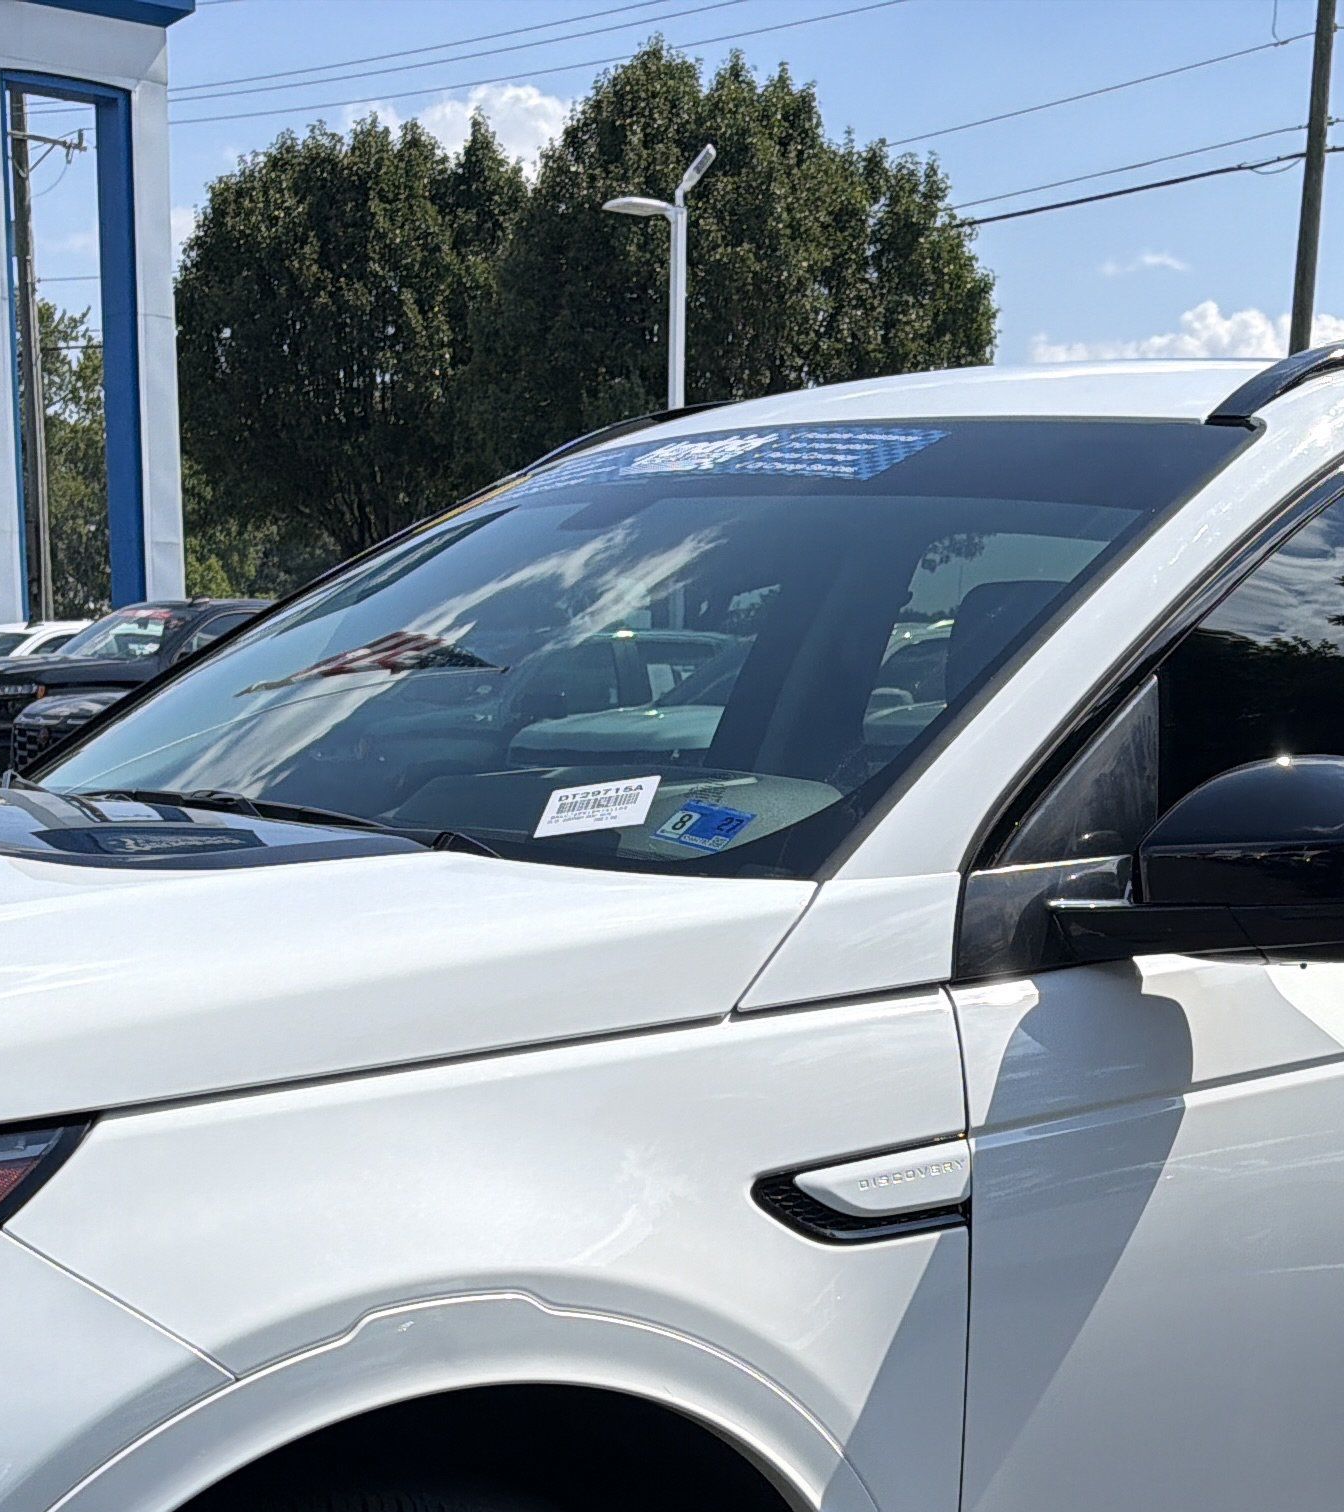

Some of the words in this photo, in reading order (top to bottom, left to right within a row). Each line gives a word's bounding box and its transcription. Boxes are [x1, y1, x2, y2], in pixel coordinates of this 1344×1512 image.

[672, 813, 693, 831] 8
[717, 816, 745, 833] 27
[857, 1159, 967, 1191] DISCOVERY
